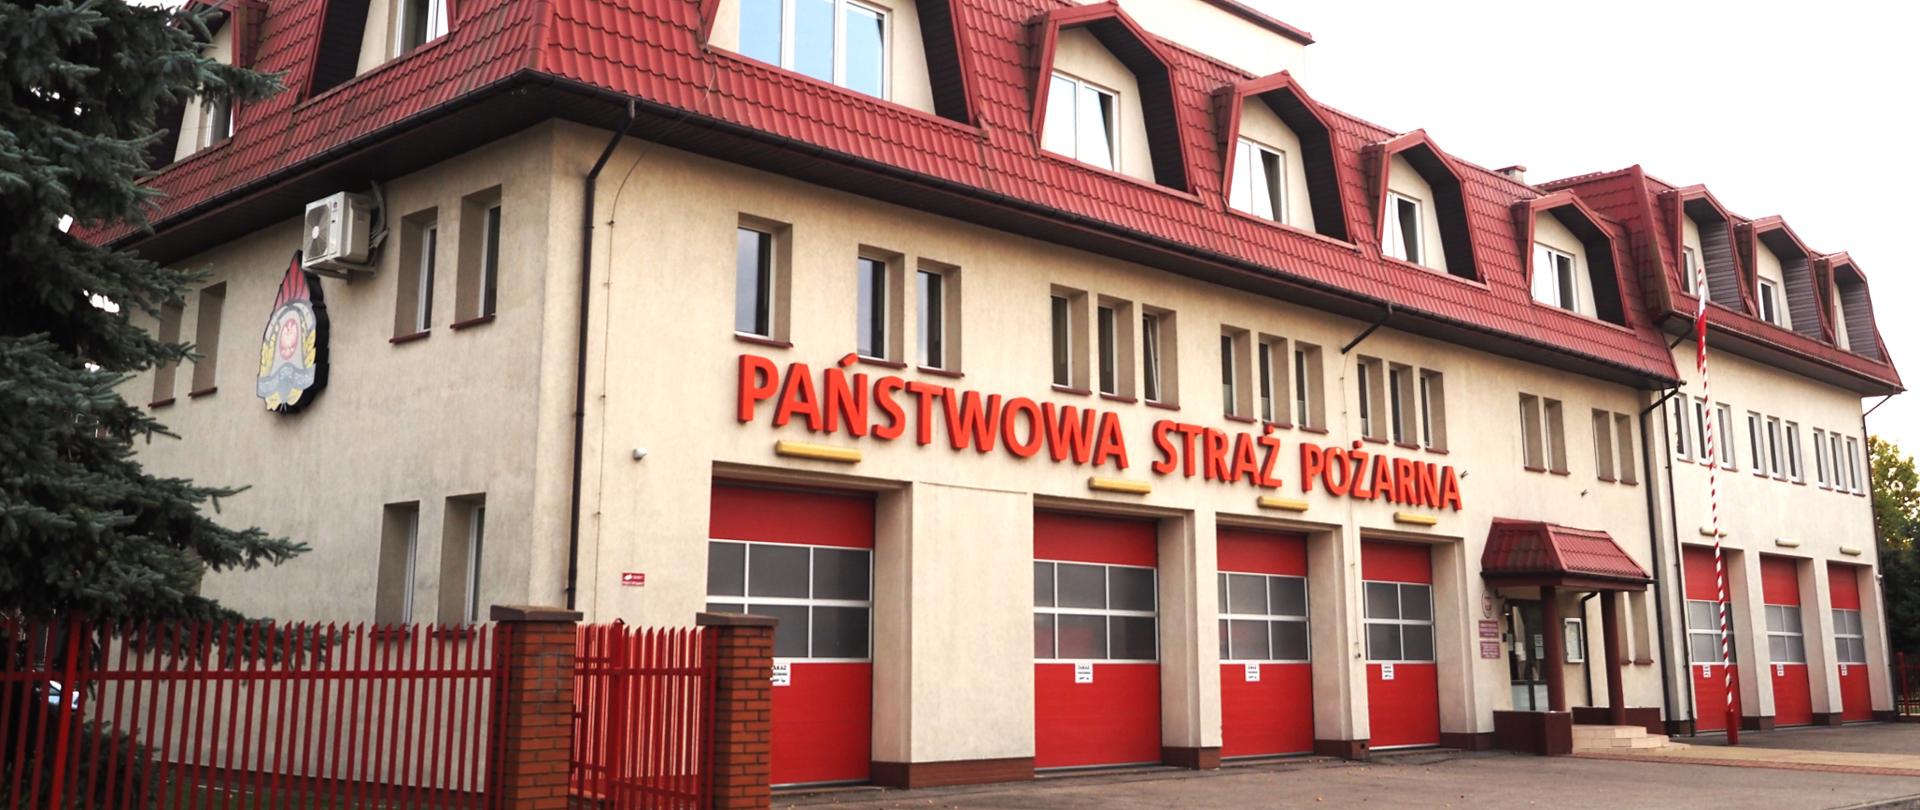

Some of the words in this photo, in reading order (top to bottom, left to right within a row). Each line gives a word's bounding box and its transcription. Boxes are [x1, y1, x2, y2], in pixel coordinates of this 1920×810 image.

[737, 352, 1129, 469] PAŃSTWOWA
[1151, 419, 1283, 488] STRAŻ
[1300, 440, 1463, 511] POŻARNA
